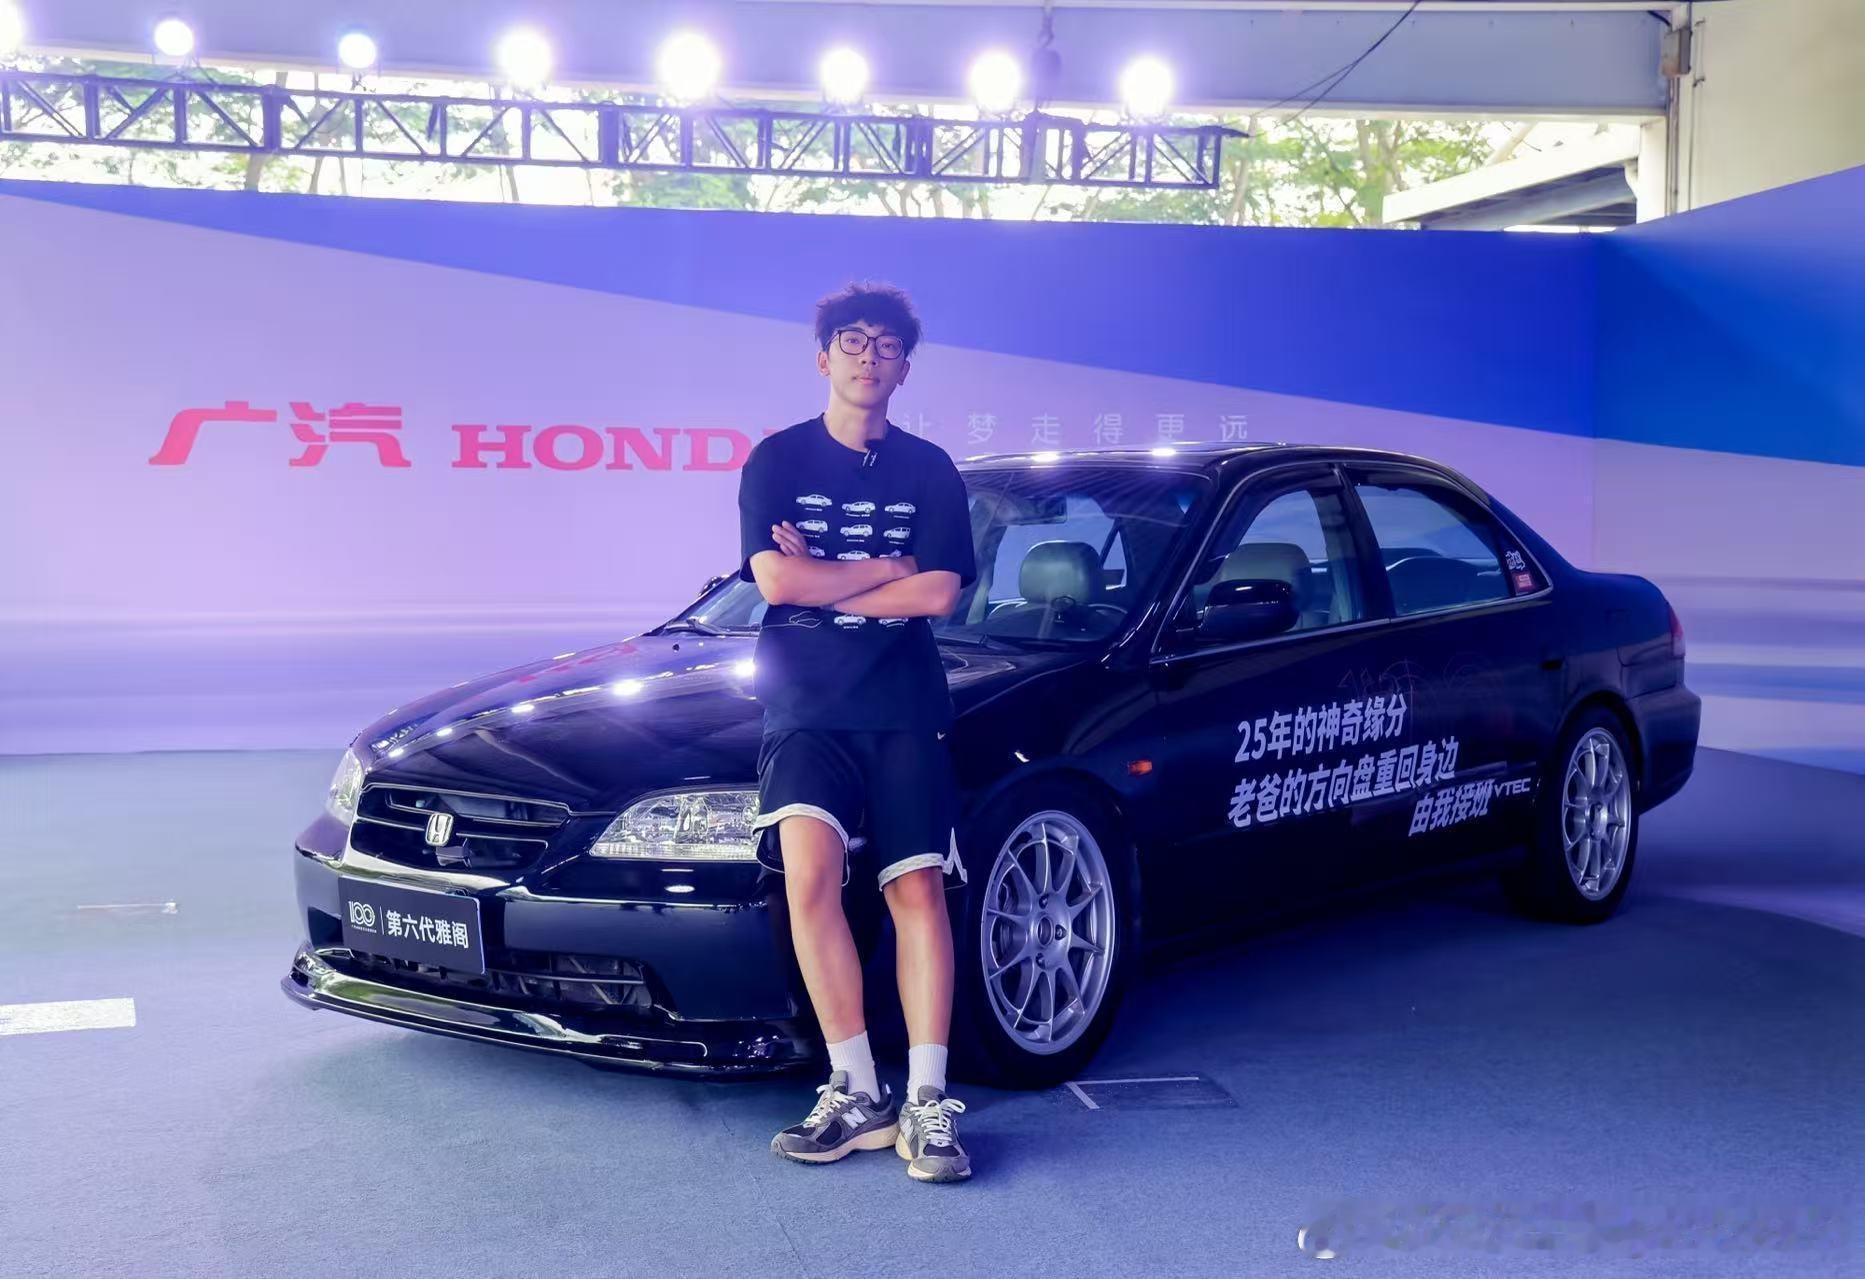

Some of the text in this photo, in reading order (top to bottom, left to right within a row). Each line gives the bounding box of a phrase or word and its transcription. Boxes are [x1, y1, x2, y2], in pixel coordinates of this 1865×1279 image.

[148, 400, 782, 472] 广汽 HOND
[903, 411, 1249, 445] 让梦走得更远
[1235, 694, 1407, 762] 25年的神奇缘分
[1227, 736, 1460, 828] 老爸的方向盘重回身边
[1494, 778, 1532, 798] VTEC
[386, 909, 469, 949] 第六代雅阁
